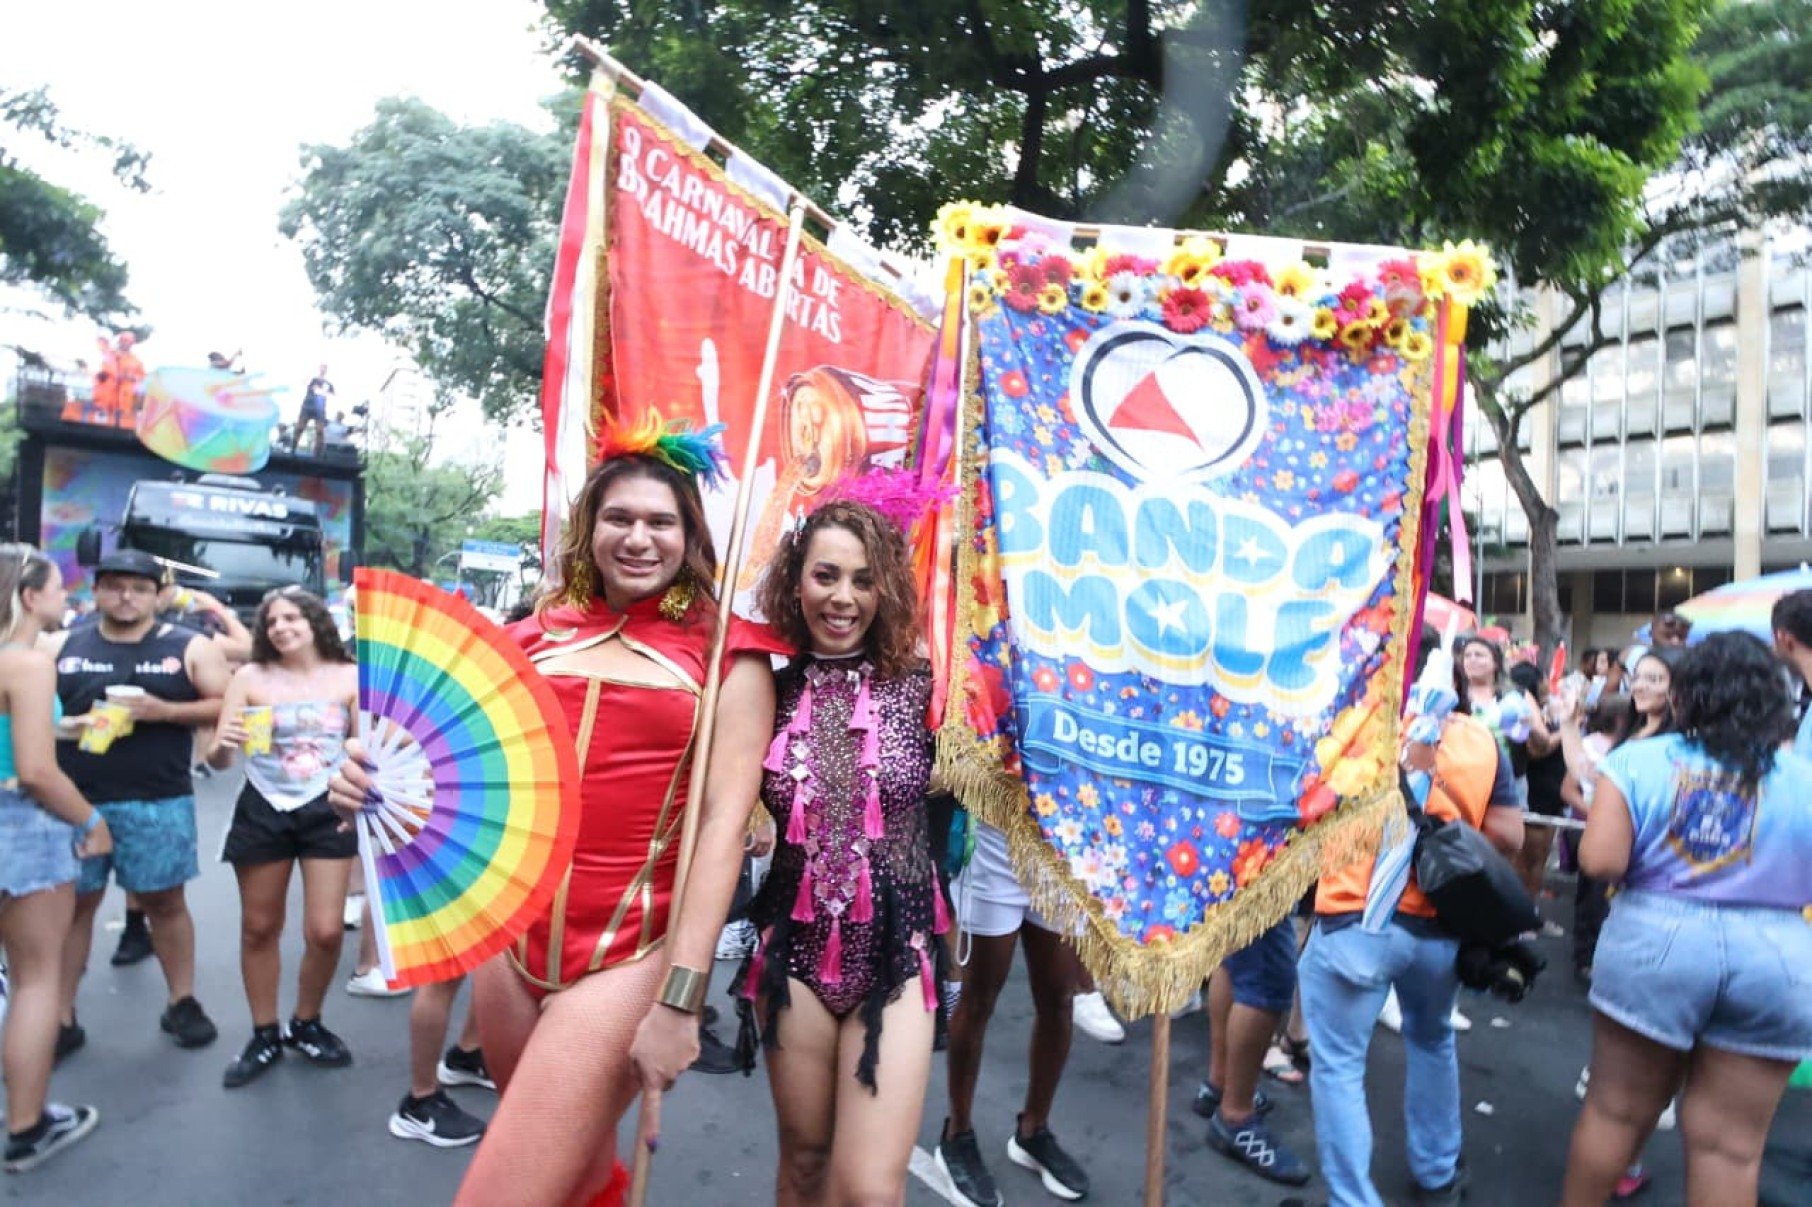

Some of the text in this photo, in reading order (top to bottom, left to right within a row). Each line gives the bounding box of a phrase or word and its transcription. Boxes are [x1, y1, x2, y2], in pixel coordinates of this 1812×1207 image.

[645, 148, 775, 261] CARNAVAL
[812, 265, 842, 308] DE
[738, 259, 842, 344] ABRTAS
[209, 494, 288, 519] RIVAS
[997, 456, 1376, 600] BANDA
[1020, 568, 1340, 694] MOLE
[1052, 709, 1246, 785] Desde 1975
